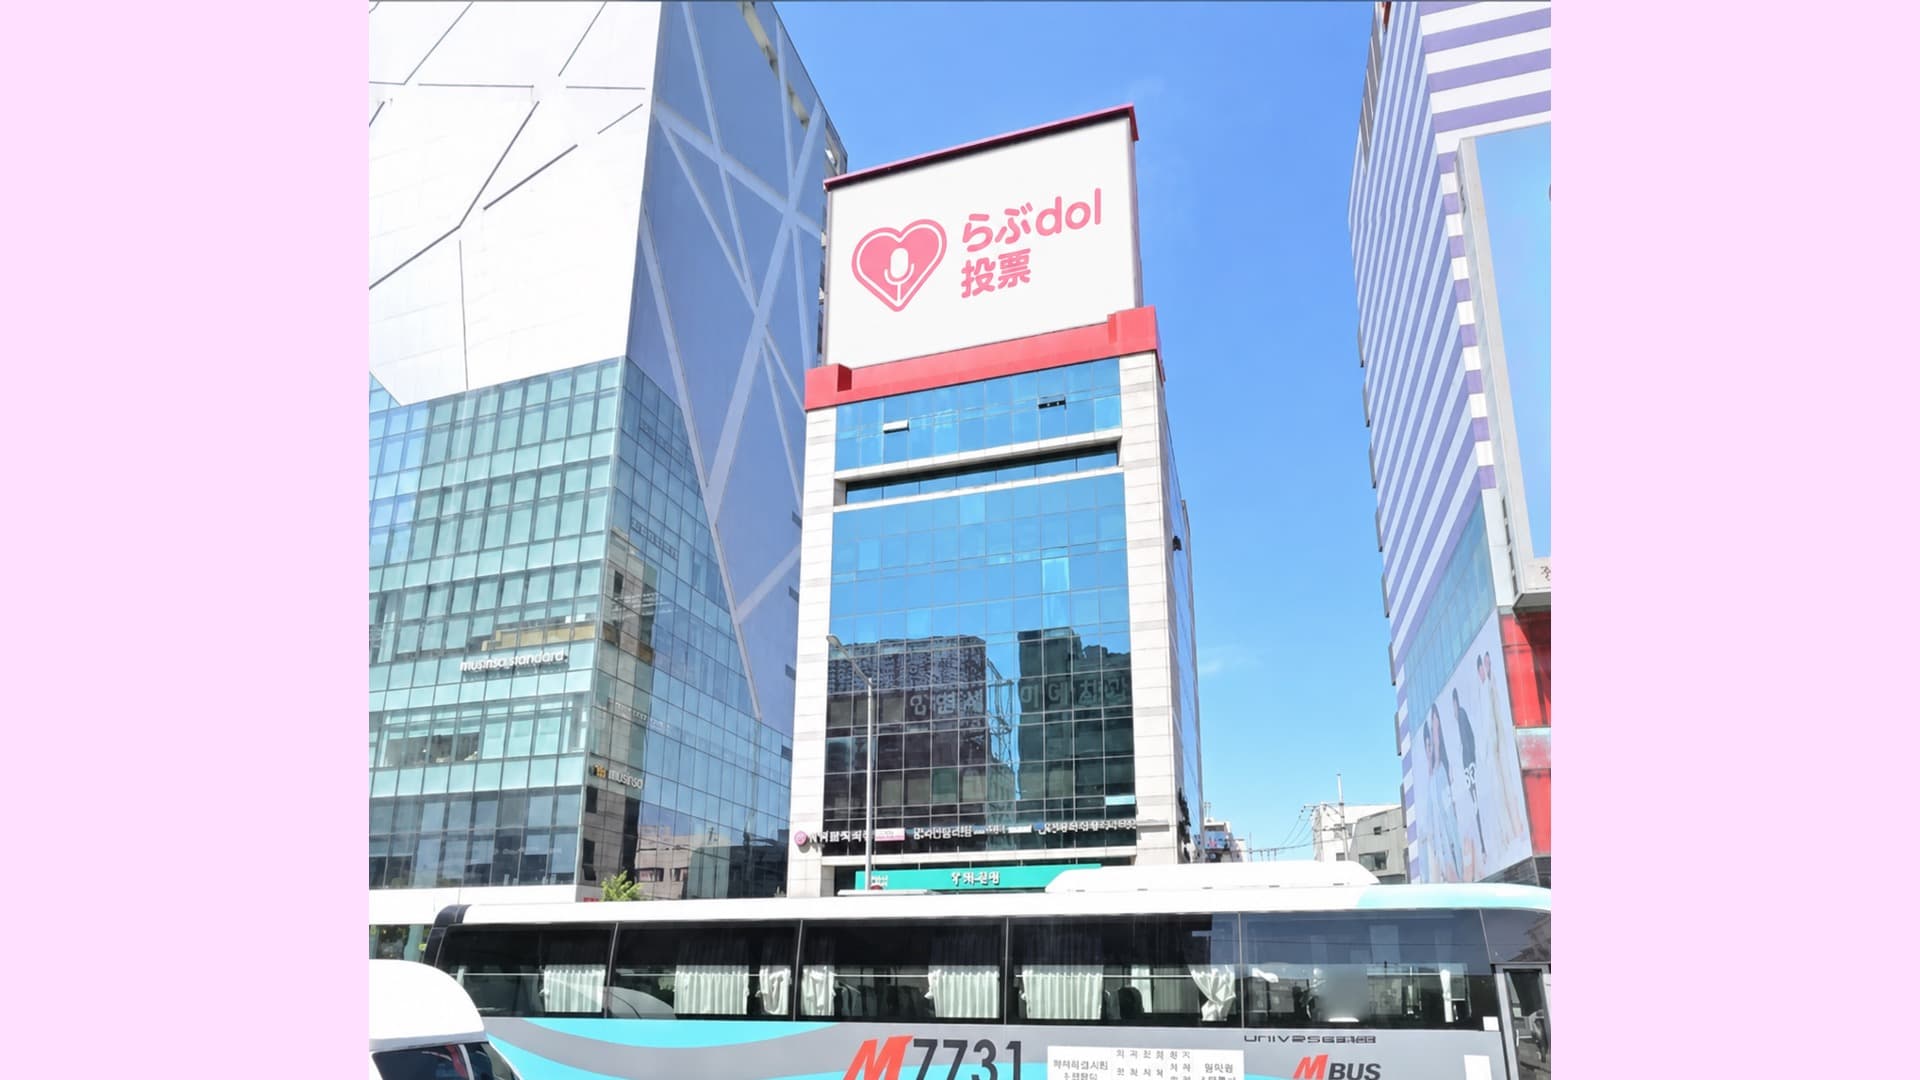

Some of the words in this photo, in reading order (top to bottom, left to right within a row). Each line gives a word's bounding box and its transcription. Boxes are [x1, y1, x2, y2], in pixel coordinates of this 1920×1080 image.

[962, 188, 1101, 252] らぶdol
[962, 248, 1031, 298] 投票
[460, 657, 506, 671] musinsa
[508, 649, 565, 666] standard
